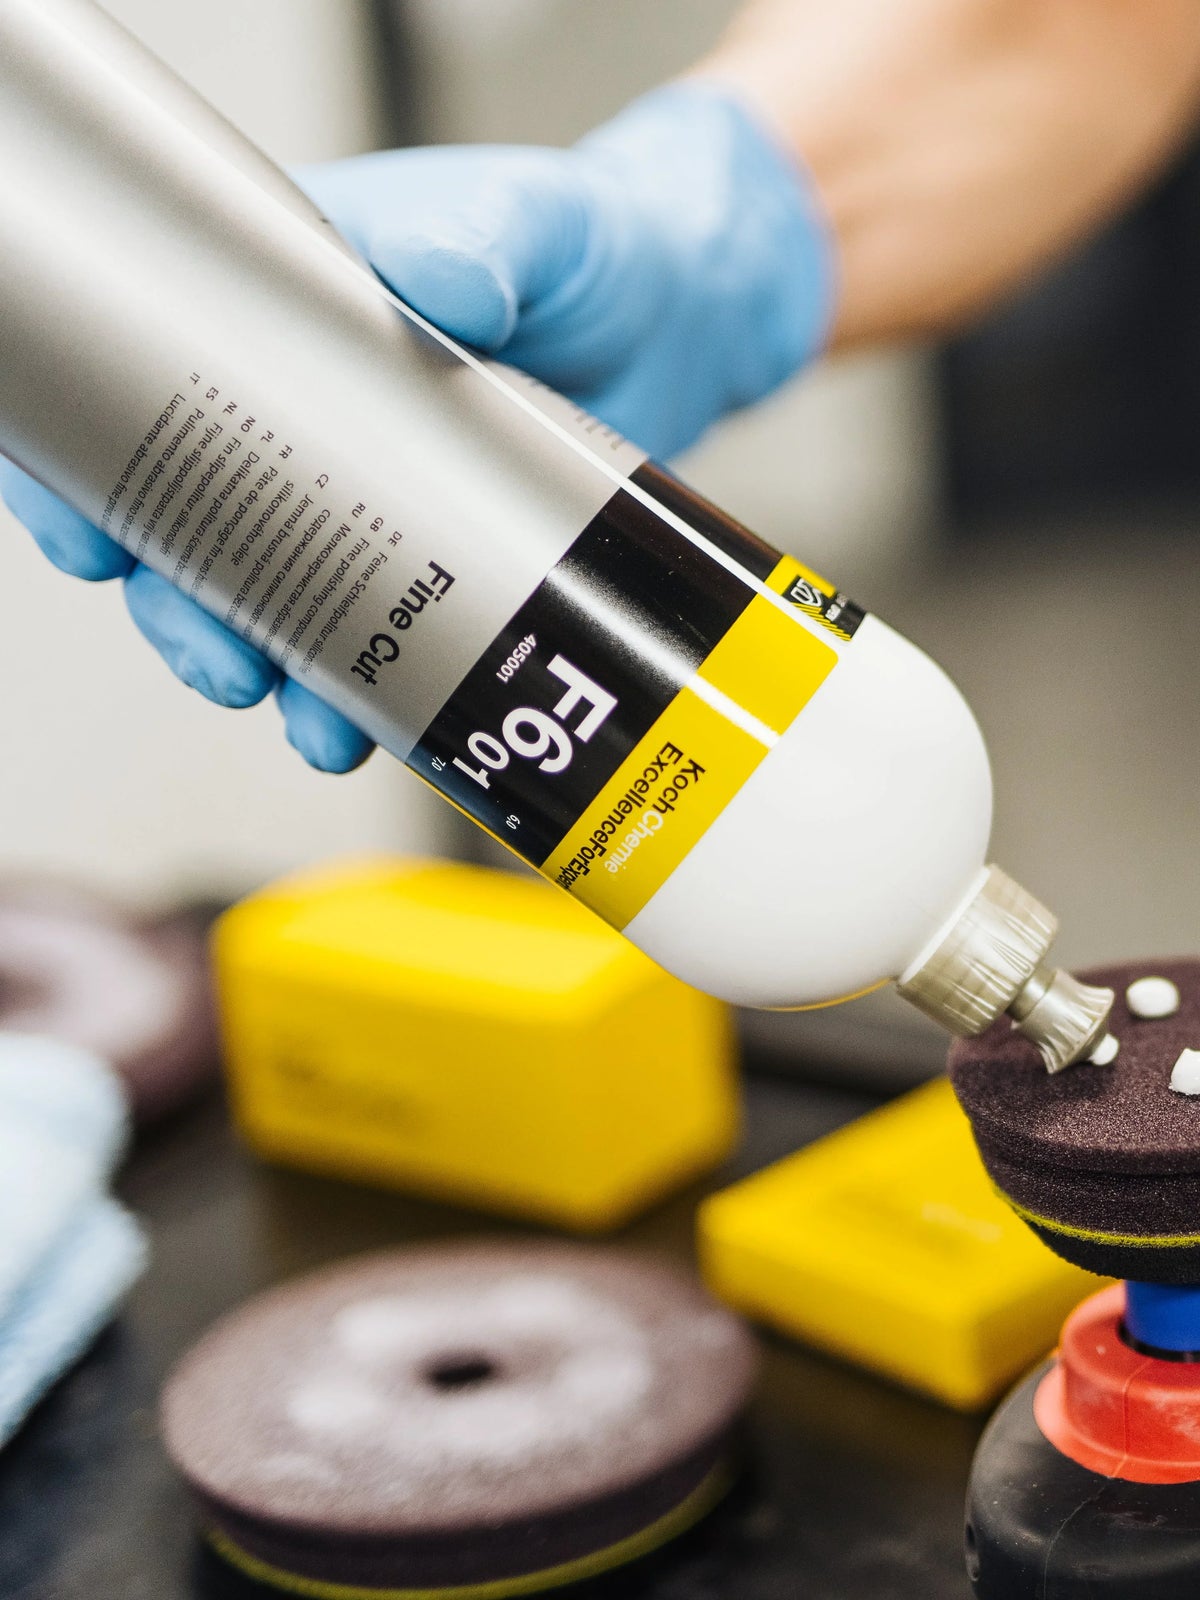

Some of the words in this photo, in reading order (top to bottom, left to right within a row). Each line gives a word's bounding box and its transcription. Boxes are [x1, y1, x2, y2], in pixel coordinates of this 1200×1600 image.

[189, 371, 200, 385] IT
[205, 386, 219, 401] ES
[143, 392, 186, 444] Lucidante
[221, 400, 238, 415] NL
[240, 415, 256, 432] NO
[161, 407, 205, 461] Pulimento
[197, 421, 223, 449] Fijne
[222, 436, 241, 454] Fin
[259, 429, 274, 442] PL
[120, 443, 148, 483] abrasivo
[277, 444, 293, 459] FR
[111, 481, 127, 499] fine
[137, 459, 165, 499] abrasivo
[151, 447, 201, 519] slijppolijstpasta
[184, 453, 226, 511] slipepolitur
[218, 450, 260, 500] Delikatna
[254, 465, 278, 490] Pâte
[314, 473, 329, 489] CZ
[128, 496, 144, 515] fino
[243, 489, 258, 505] de
[245, 479, 294, 543] silikonového
[283, 493, 314, 531] Jemná
[351, 501, 366, 518] RU
[194, 497, 223, 536] politura
[216, 501, 248, 546] ponçage
[369, 516, 383, 532] GB
[208, 543, 223, 557] fin
[230, 542, 249, 566] oleje
[259, 528, 290, 564] brusná
[281, 508, 330, 572] содержания
[346, 537, 370, 561] Fine
[386, 530, 403, 547] DE
[199, 555, 213, 575] sans
[239, 559, 264, 595] politura
[286, 522, 351, 605] Мелкозернистая
[360, 551, 388, 581] Feine
[312, 557, 350, 606] polishing
[388, 561, 454, 630] Fine
[318, 579, 366, 641] Schleifpolitur
[349, 632, 400, 685] Cut
[495, 634, 536, 682] 405001
[604, 759, 705, 872] KochChemie
